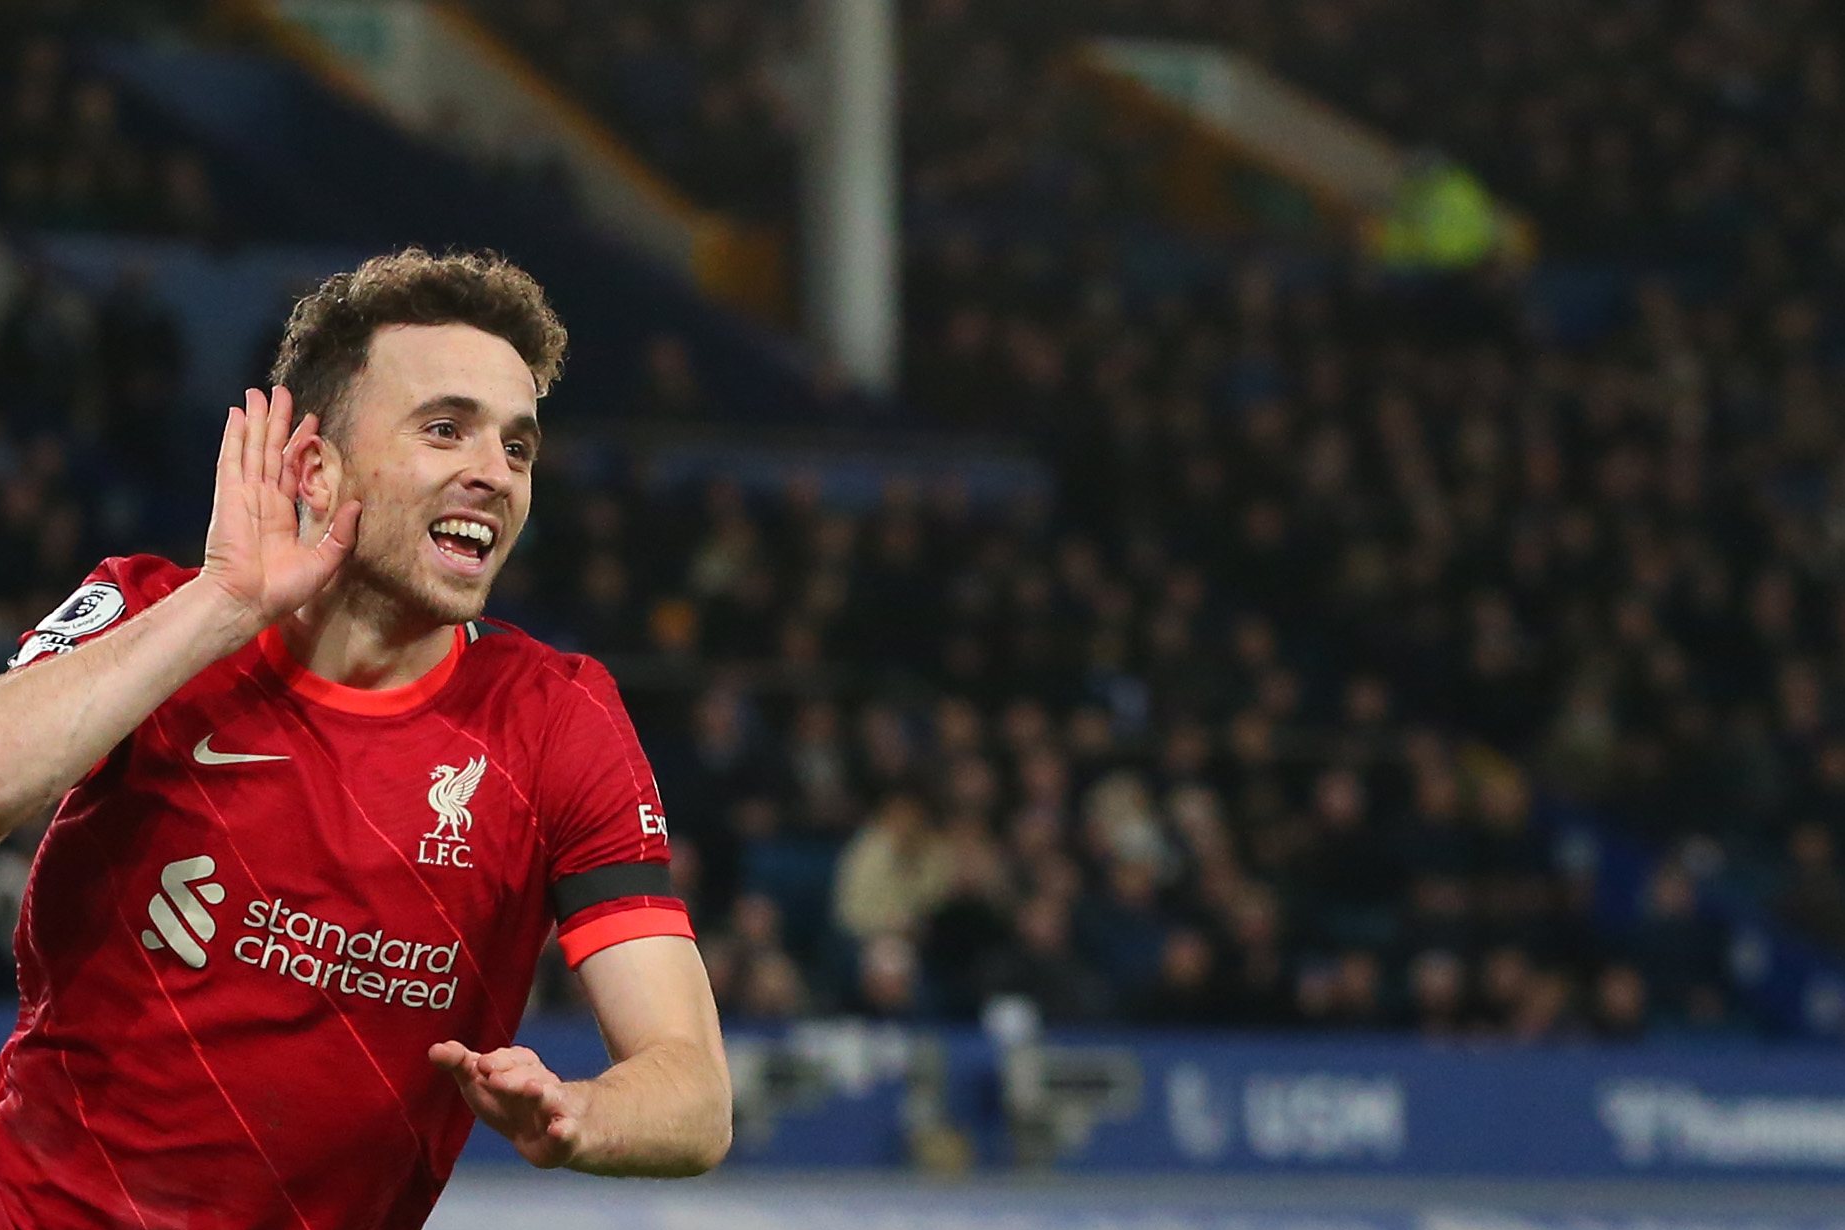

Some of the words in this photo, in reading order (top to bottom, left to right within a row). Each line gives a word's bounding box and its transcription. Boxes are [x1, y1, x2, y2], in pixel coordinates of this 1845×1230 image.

[417, 841, 474, 869] L.F.C.
[234, 934, 459, 1010] chartered
[243, 898, 460, 974] standard
